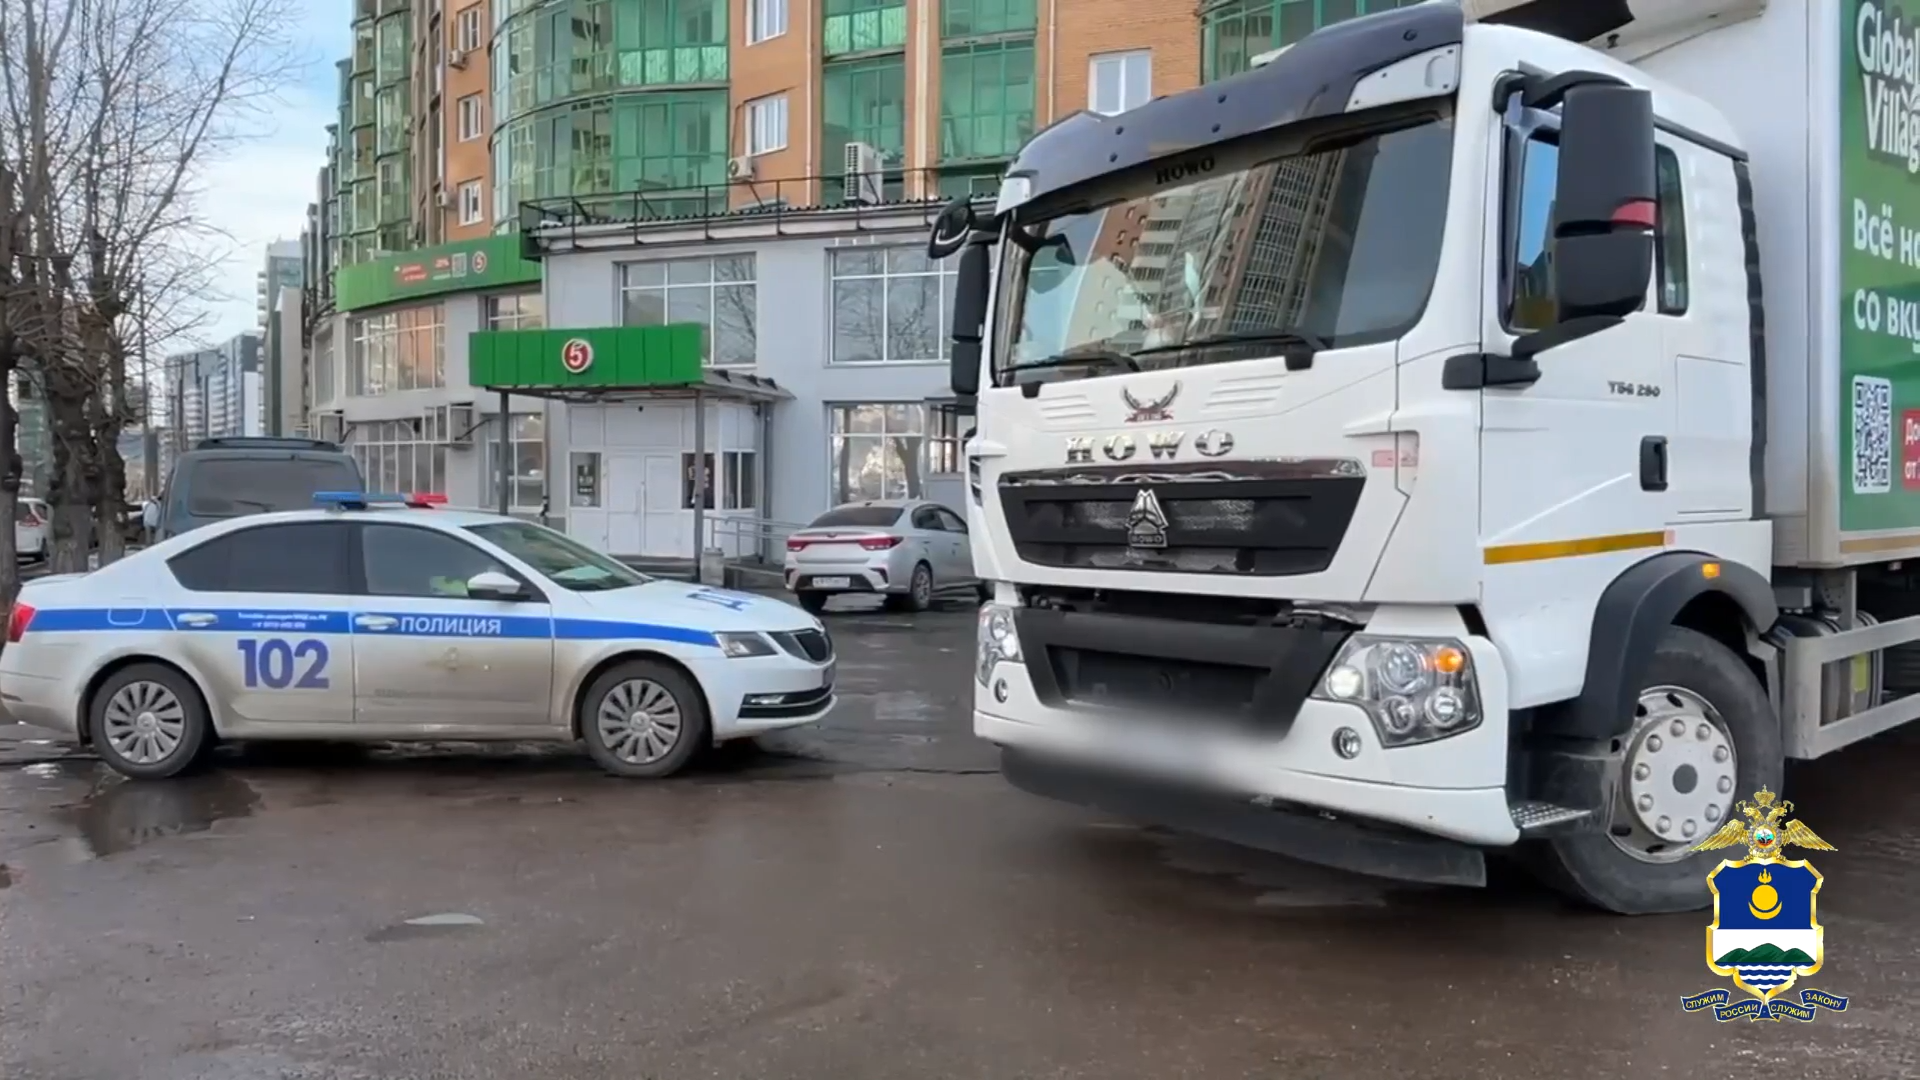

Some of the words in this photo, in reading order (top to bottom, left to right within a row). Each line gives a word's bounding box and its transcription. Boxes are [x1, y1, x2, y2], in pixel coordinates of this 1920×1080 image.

[1857, 1, 1920, 85] Global
[1156, 157, 1215, 185] HOWO
[1854, 197, 1893, 260] Всё
[1064, 429, 1235, 465] HOWO
[1131, 534, 1162, 544] HOWO
[400, 616, 501, 636] ПОЛИЦИЯ
[237, 638, 330, 690] 102
